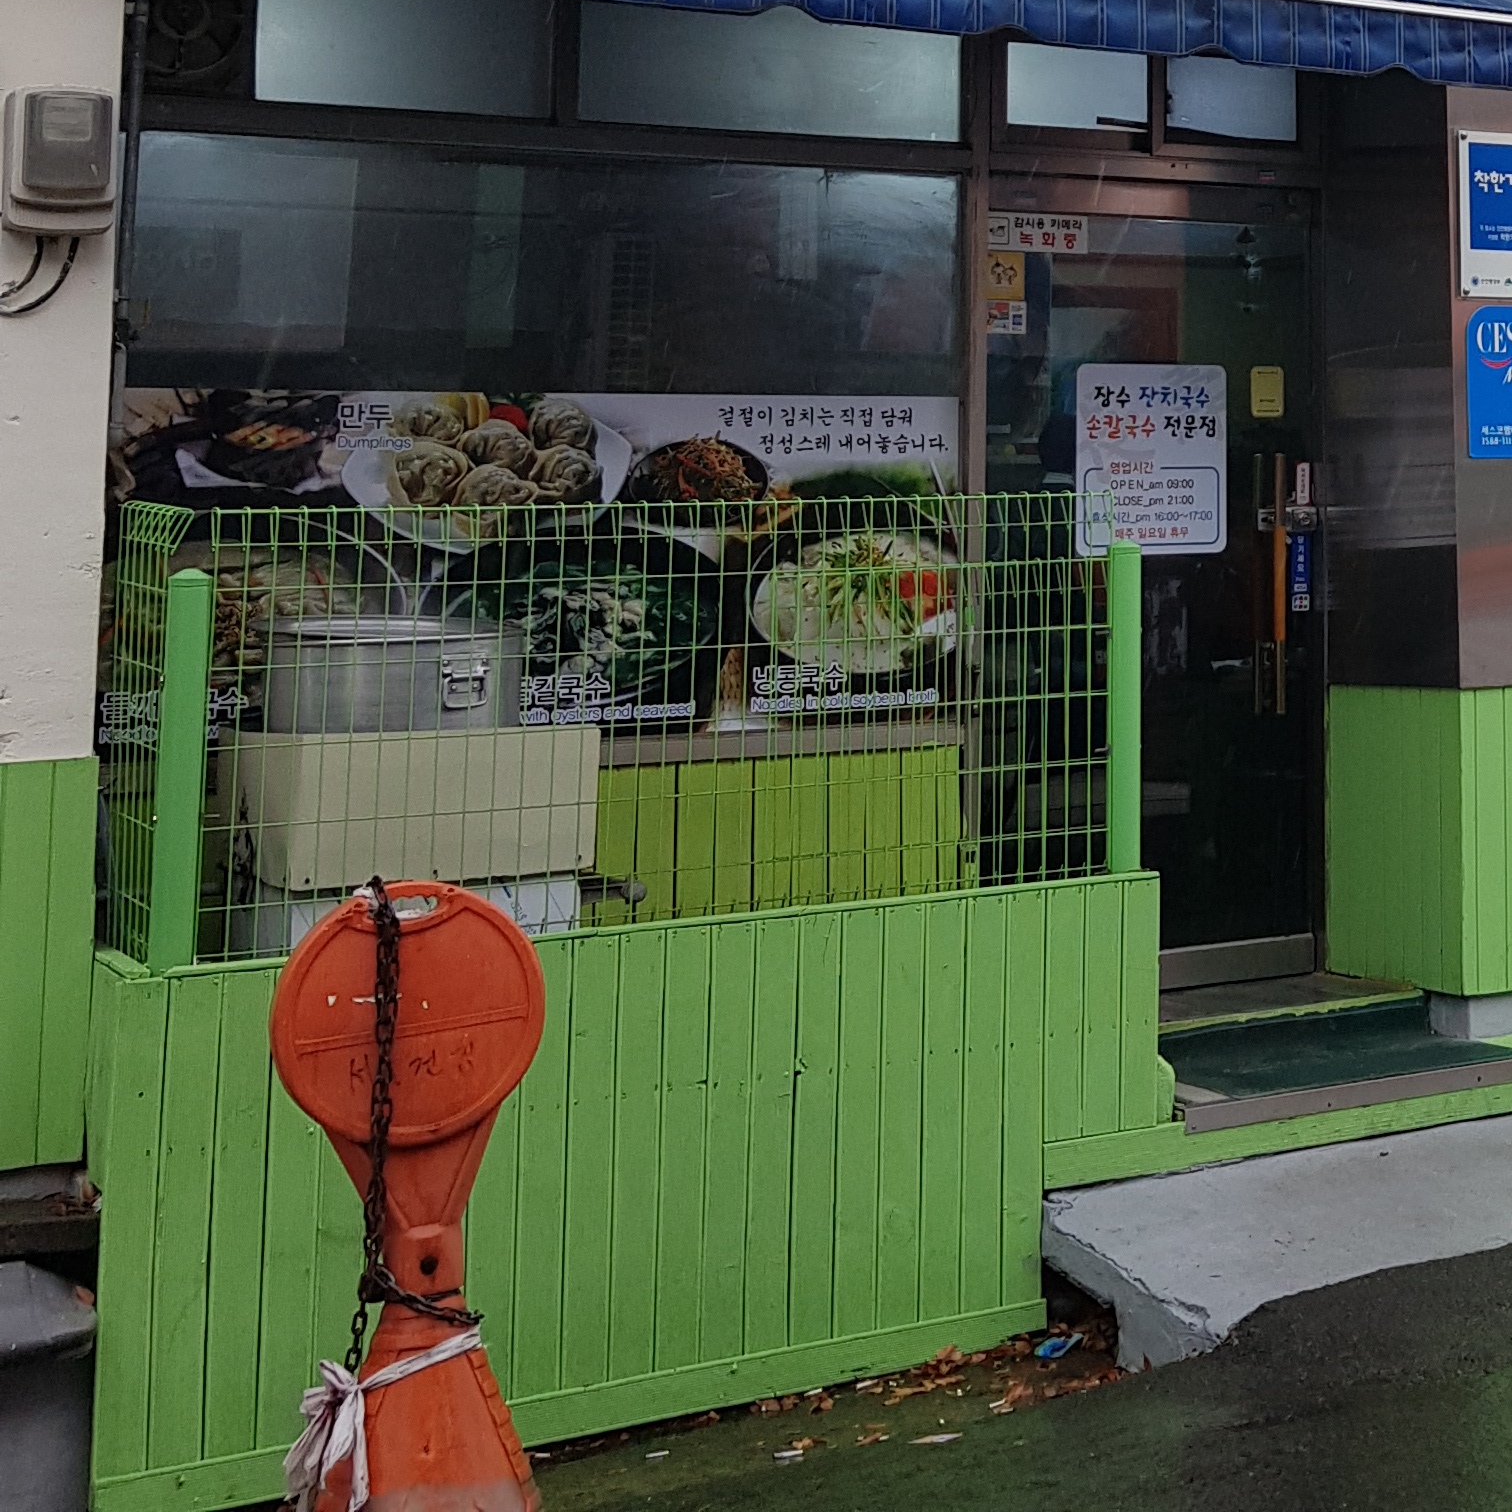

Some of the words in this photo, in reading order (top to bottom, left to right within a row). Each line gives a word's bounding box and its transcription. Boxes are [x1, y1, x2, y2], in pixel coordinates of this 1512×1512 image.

[1014, 216, 1045, 230] 감시용
[1050, 218, 1083, 231] 카메라
[1094, 386, 1131, 408] 장수
[1139, 386, 1211, 409] 잔치국수
[337, 402, 393, 430] 만두
[718, 405, 773, 428] 겉절이
[780, 406, 835, 427] 김치는
[839, 406, 873, 428] 직접
[881, 406, 913, 428] 담궈
[1086, 414, 1156, 439] 손칼국수
[1163, 414, 1217, 439] 전문점
[336, 435, 413, 451] Dumplings
[759, 433, 830, 454] 정성스레
[1110, 461, 1154, 475] 영업시간
[1166, 479, 1194, 489] 09:00
[1167, 495, 1194, 505] 21:00
[1115, 528, 1135, 539] 매주
[1137, 527, 1167, 539] 일요일
[1170, 526, 1189, 538] 휴무
[751, 694, 804, 713] Noodles
[806, 694, 818, 710] in
